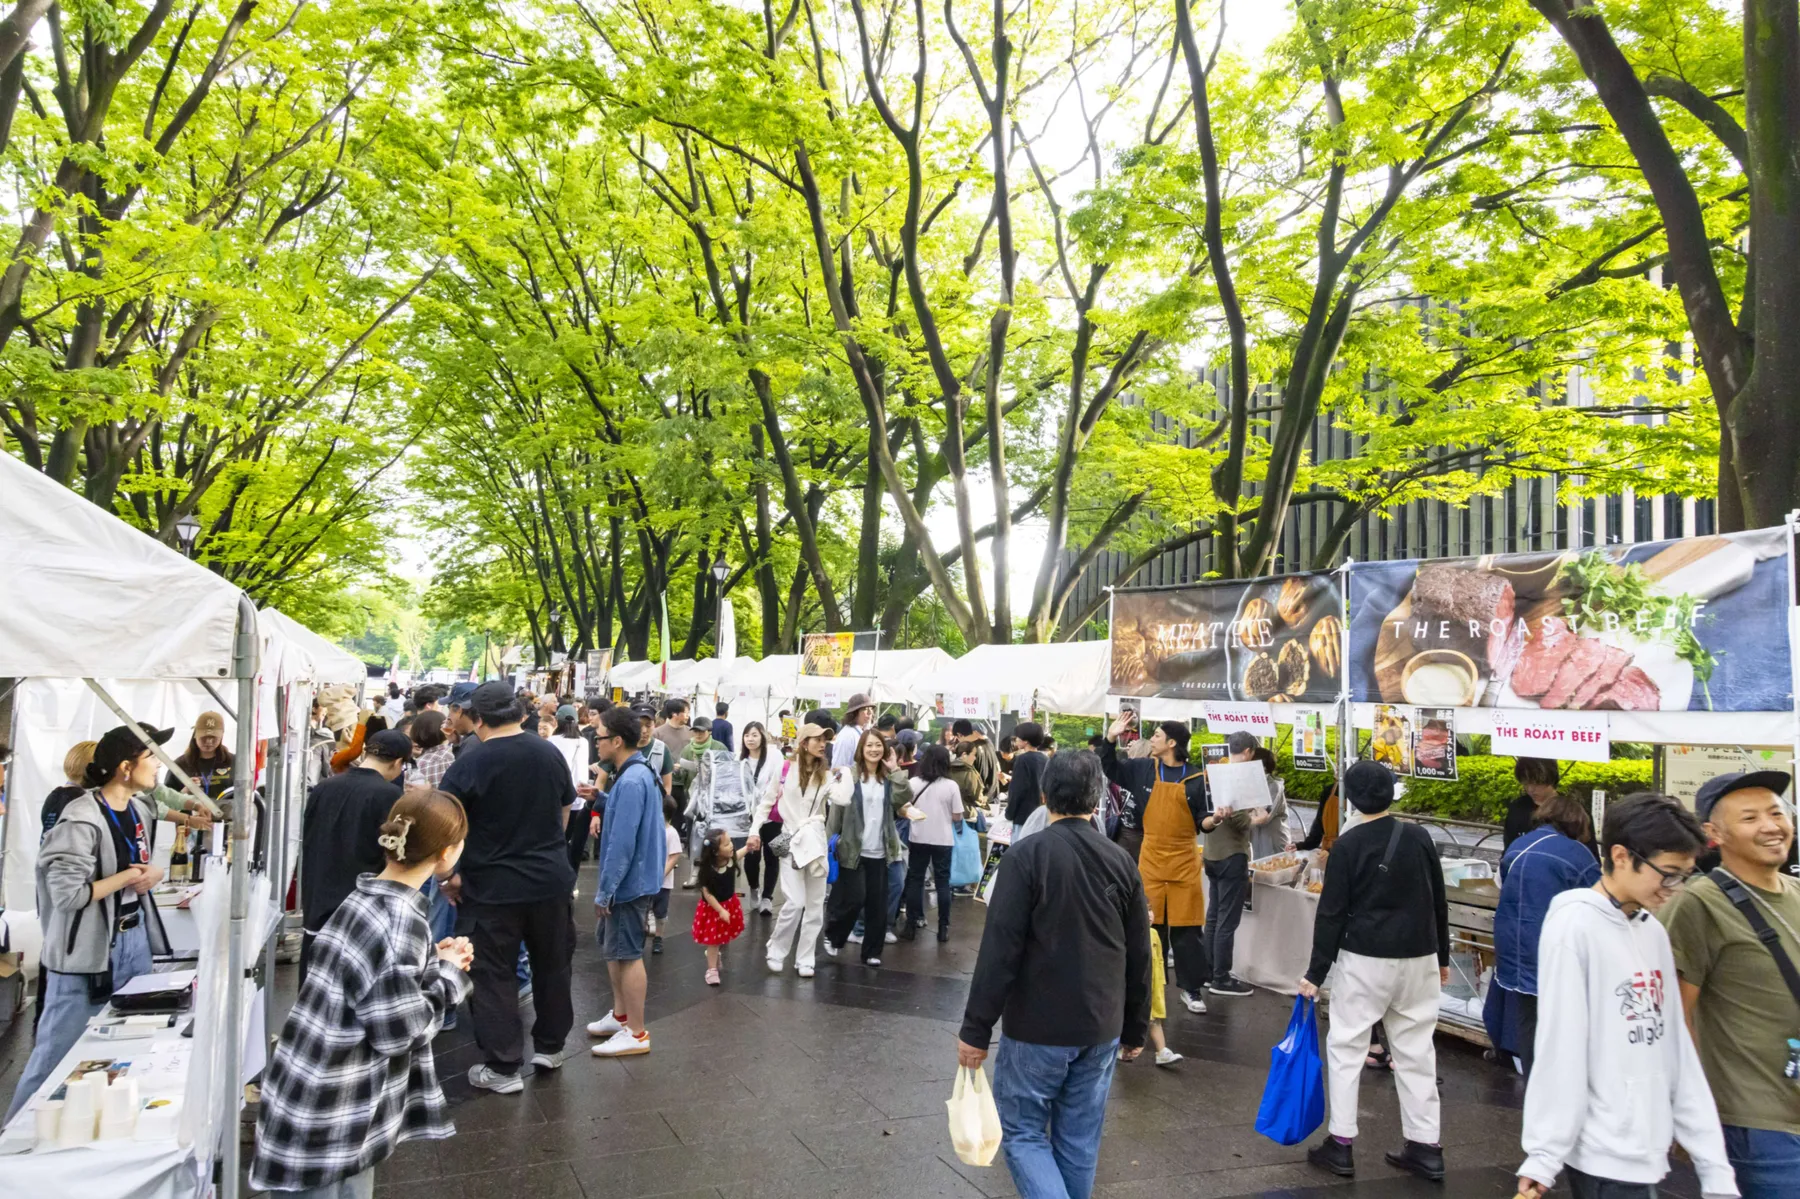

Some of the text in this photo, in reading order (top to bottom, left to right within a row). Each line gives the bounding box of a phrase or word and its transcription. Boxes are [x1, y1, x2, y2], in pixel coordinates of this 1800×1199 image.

[1393, 603, 1706, 639] THE ROAST BEEF
[1157, 618, 1275, 650] MEAT PIE
[1182, 681, 1195, 689] THE
[1207, 713, 1222, 721] THE
[1224, 714, 1249, 723] ROAST
[1251, 715, 1269, 724] BEEF
[1496, 727, 1602, 743] THE ROAST BEEF
[1445, 722, 1454, 775] ローストビーフ
[1416, 766, 1437, 776] 1,000
[1628, 1025, 1644, 1044] all
